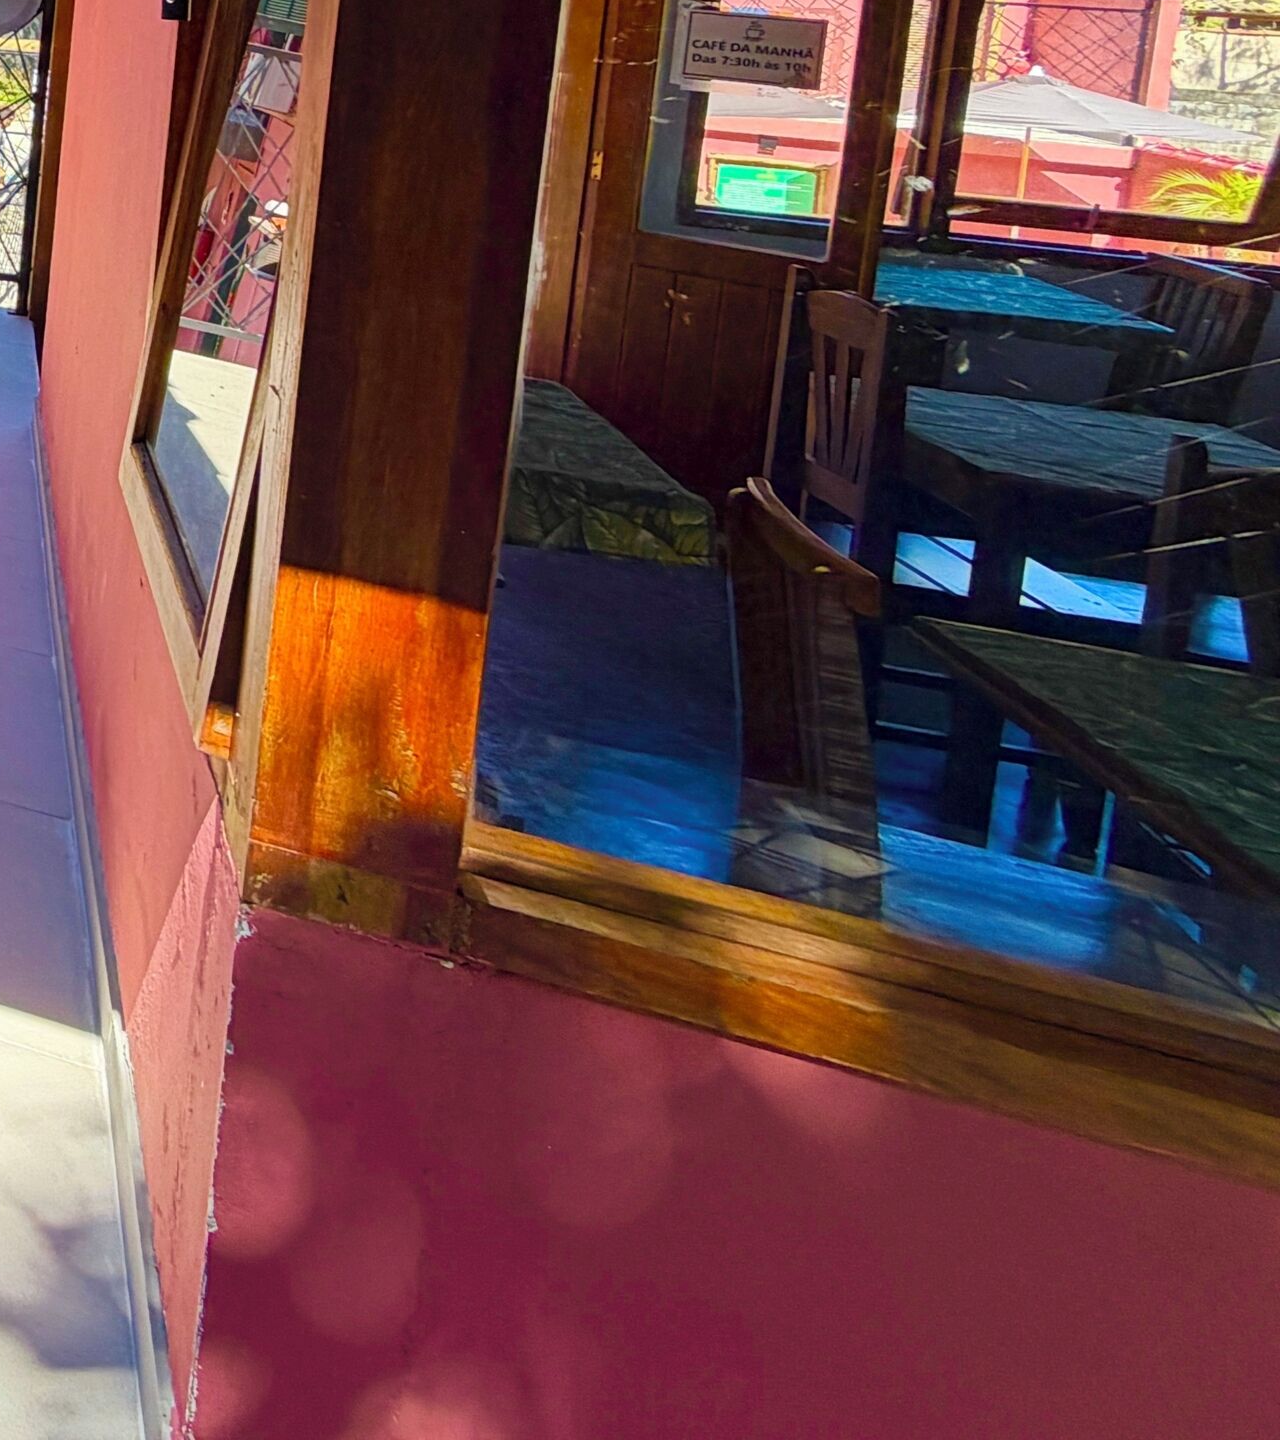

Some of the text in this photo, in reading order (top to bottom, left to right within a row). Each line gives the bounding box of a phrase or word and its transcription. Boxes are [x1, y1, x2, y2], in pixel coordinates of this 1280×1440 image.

[692, 38, 814, 59] CAFÉ DA MANHÃ
[692, 53, 717, 64] Das
[721, 55, 760, 68] 7:30h
[784, 62, 811, 73] 10h
